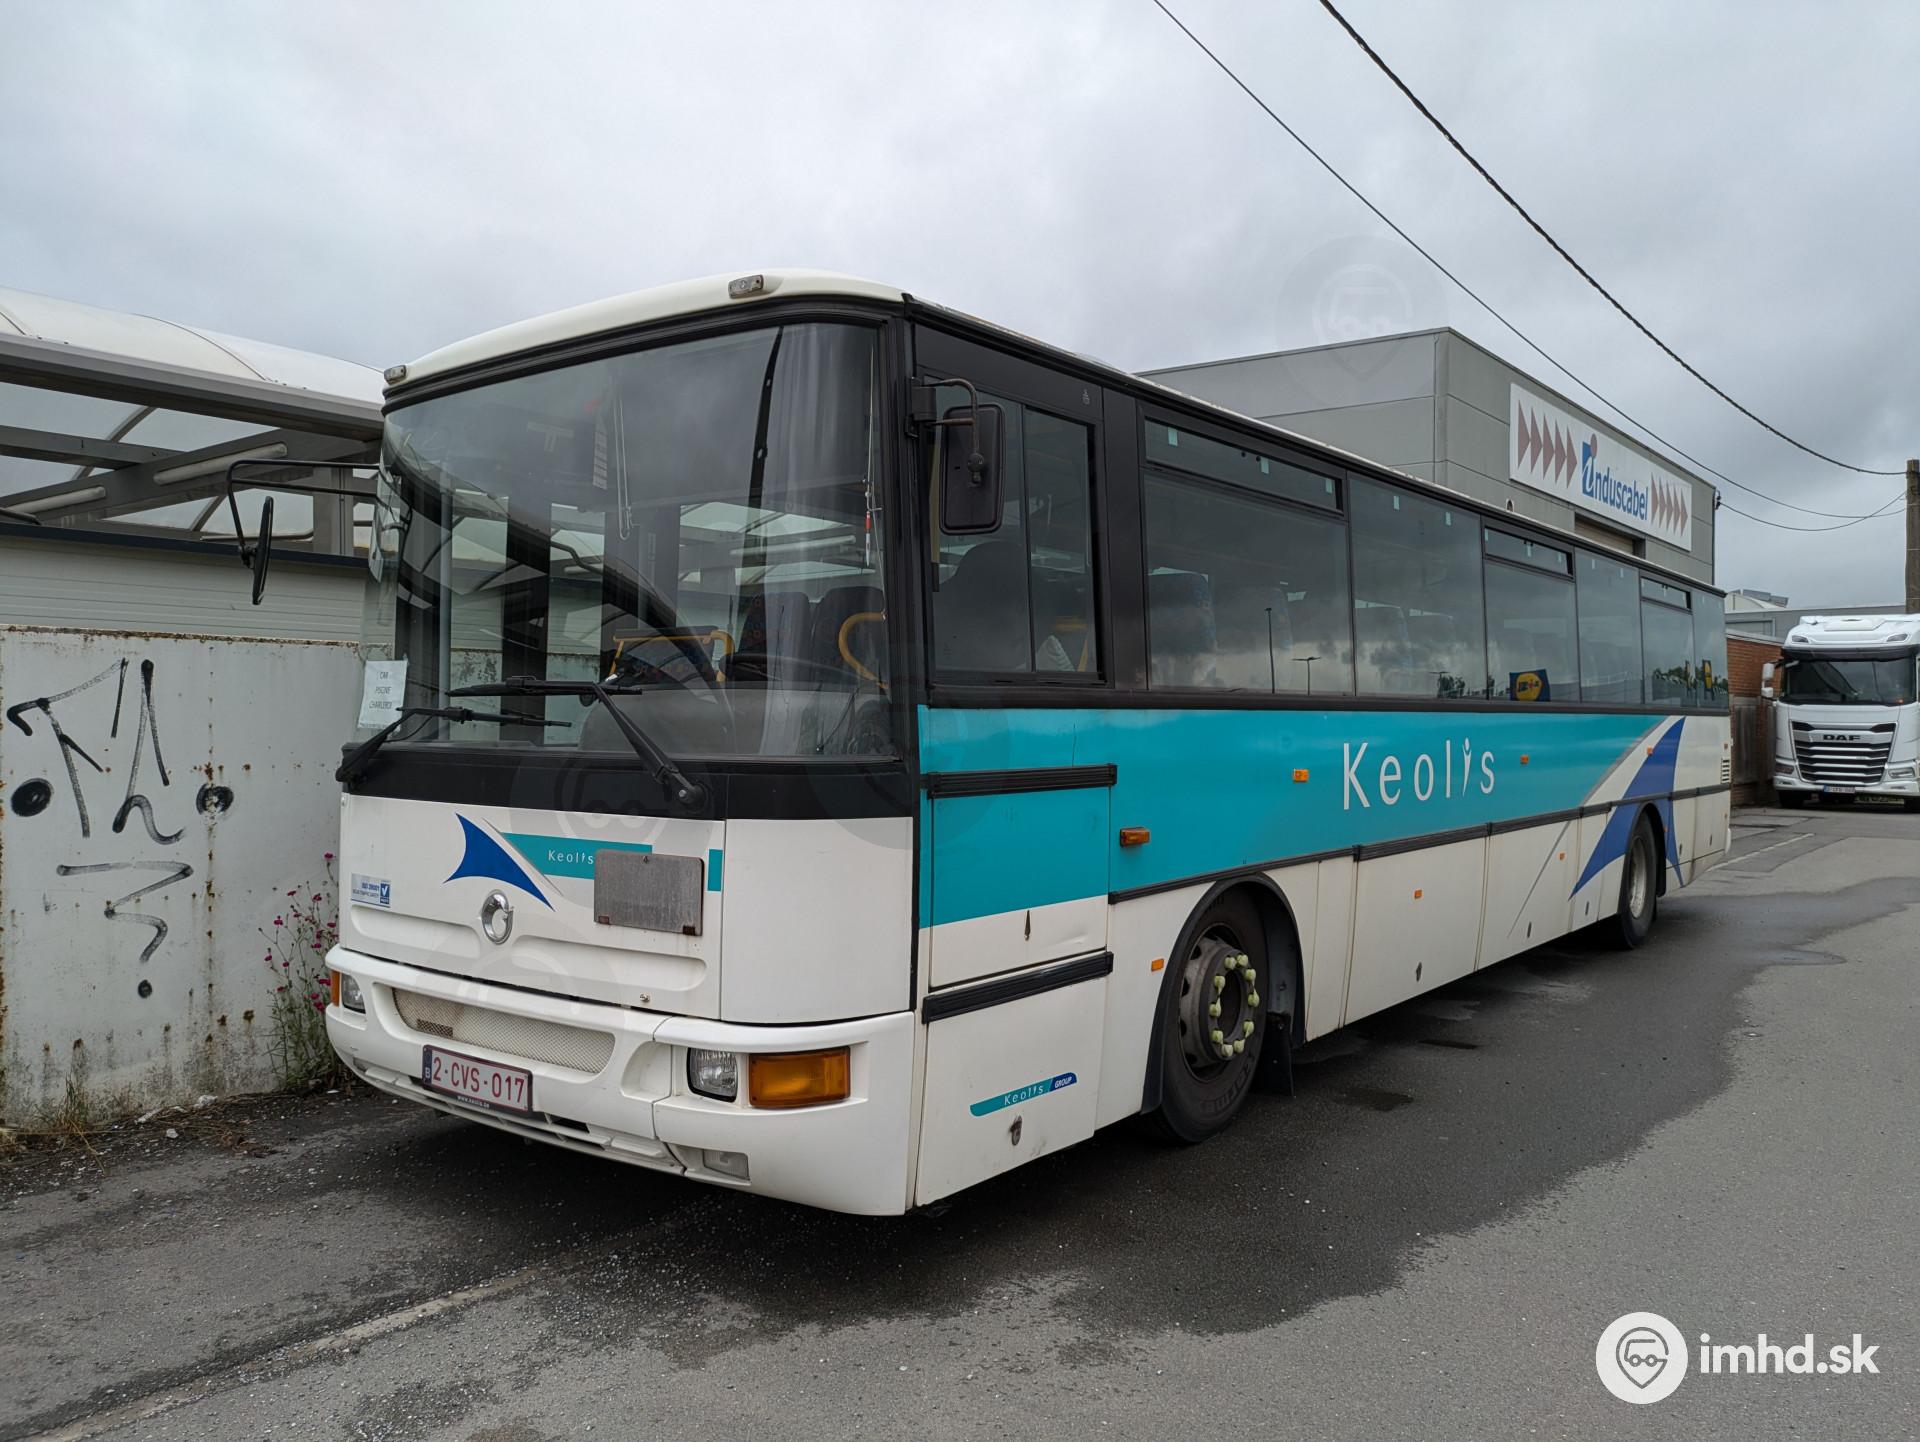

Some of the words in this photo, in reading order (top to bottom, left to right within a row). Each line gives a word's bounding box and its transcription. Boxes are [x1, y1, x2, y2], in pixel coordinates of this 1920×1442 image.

[1343, 737, 1496, 810] Keolis
[548, 849, 594, 865] Keolis
[424, 1067, 431, 1079] B
[1004, 1084, 1045, 1106] Keolis
[1054, 1076, 1073, 1089] GROUP
